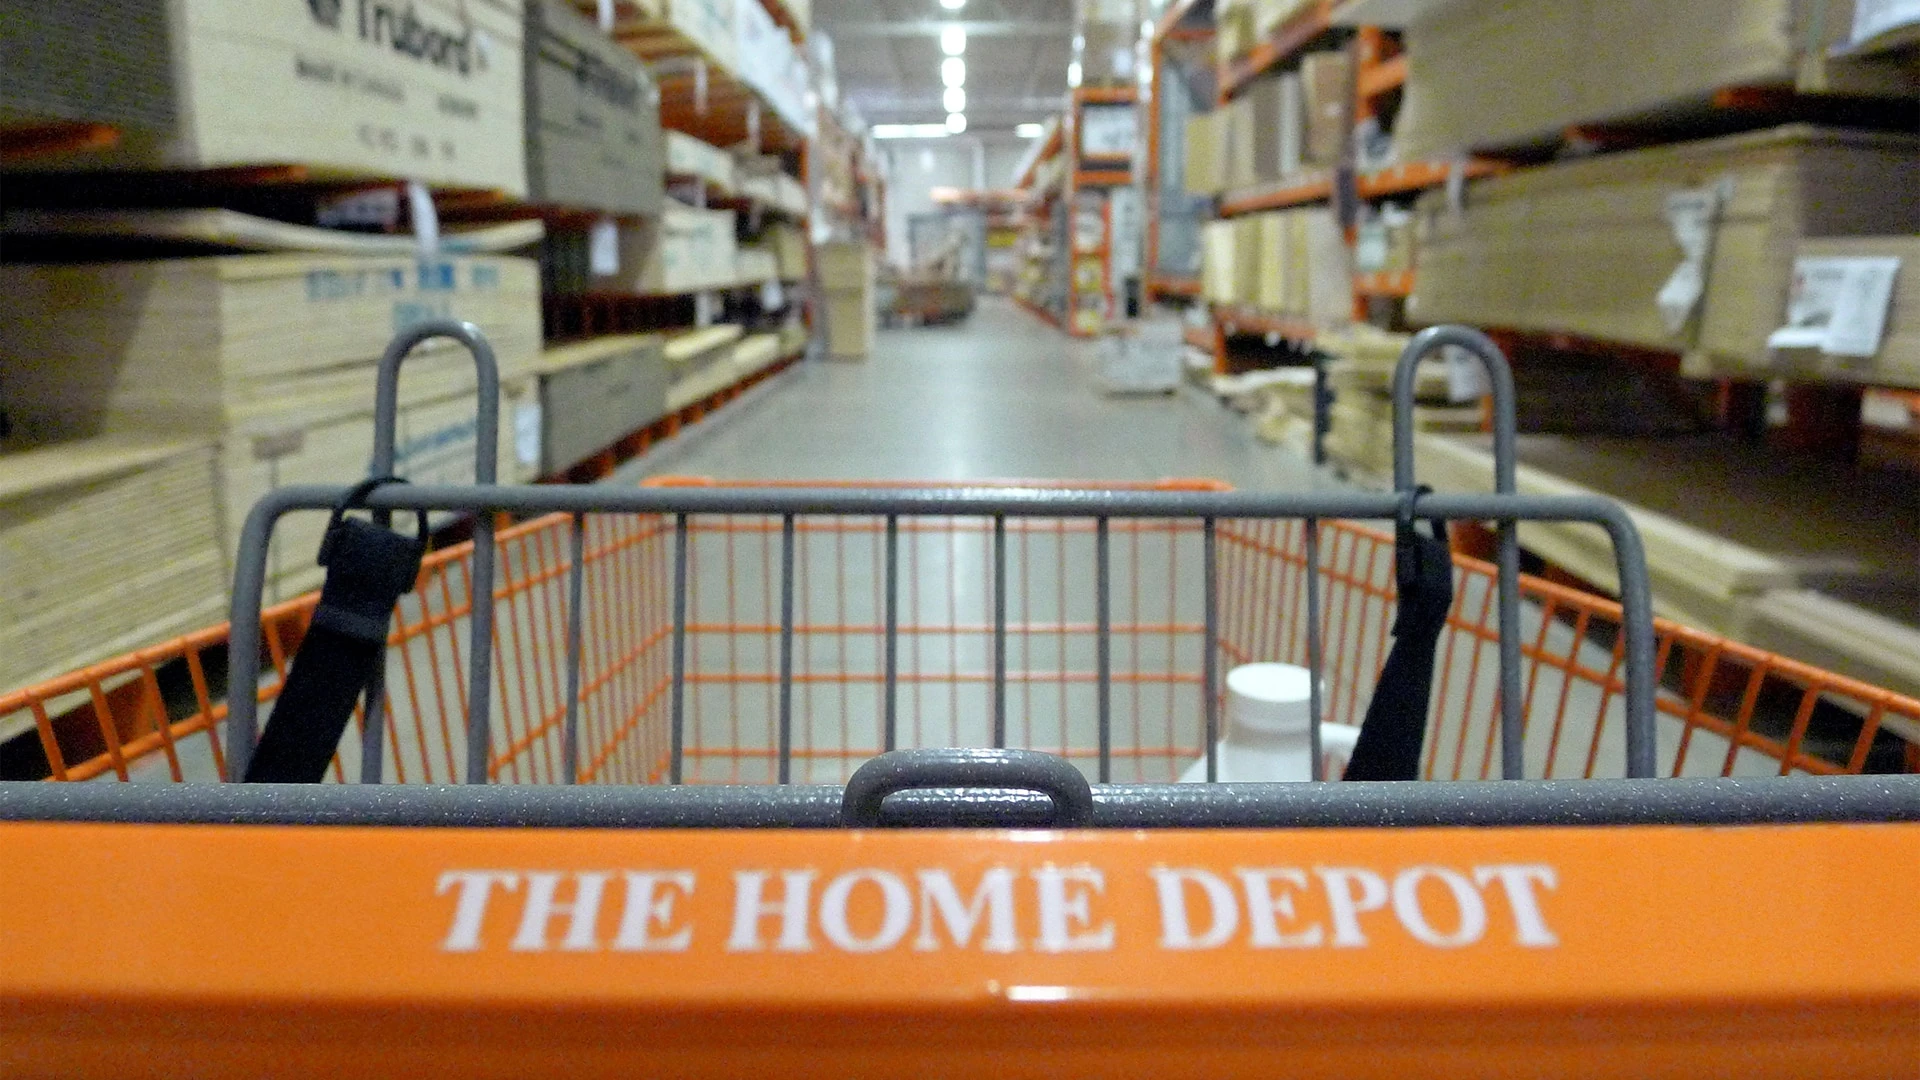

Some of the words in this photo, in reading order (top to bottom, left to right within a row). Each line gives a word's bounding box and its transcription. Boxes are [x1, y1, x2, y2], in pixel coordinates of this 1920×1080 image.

[436, 868, 696, 952] THE
[726, 867, 1115, 952] HOME
[1150, 864, 1560, 950] DEPOT
